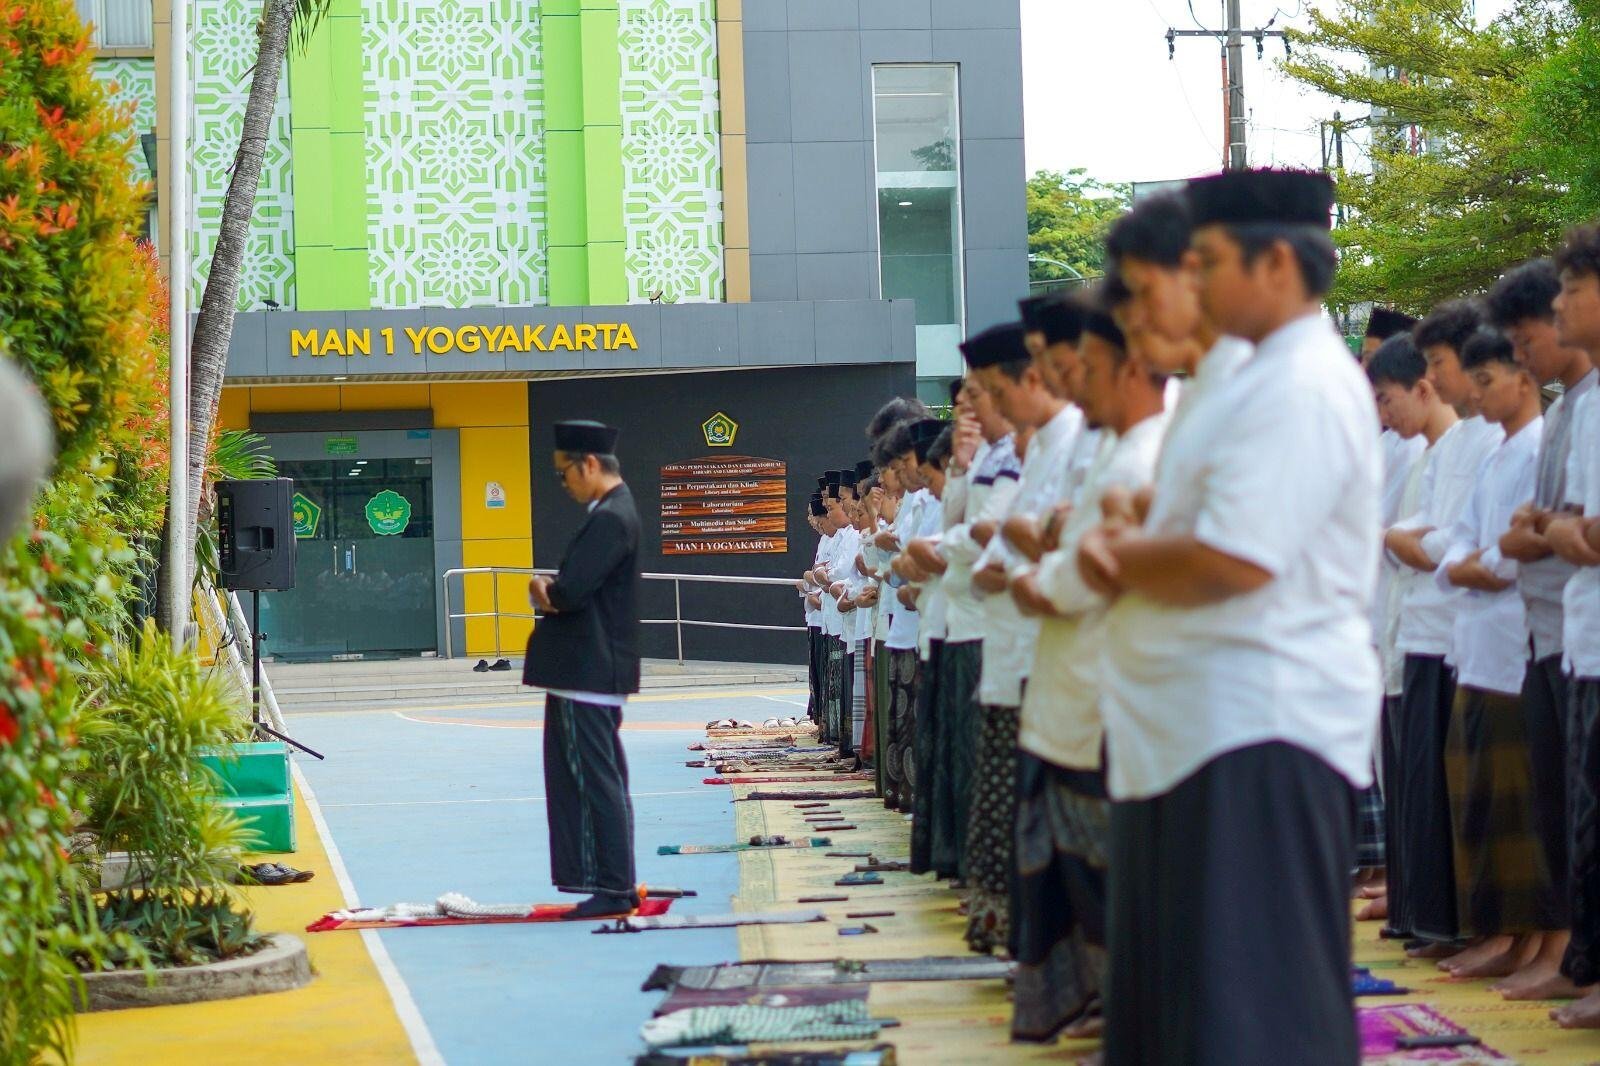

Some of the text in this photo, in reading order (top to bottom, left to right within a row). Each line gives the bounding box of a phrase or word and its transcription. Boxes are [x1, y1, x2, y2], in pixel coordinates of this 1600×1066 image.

[291, 323, 638, 356] MAN 1 YOGYAKARTA
[707, 541, 774, 550] YOGYAKARTA
